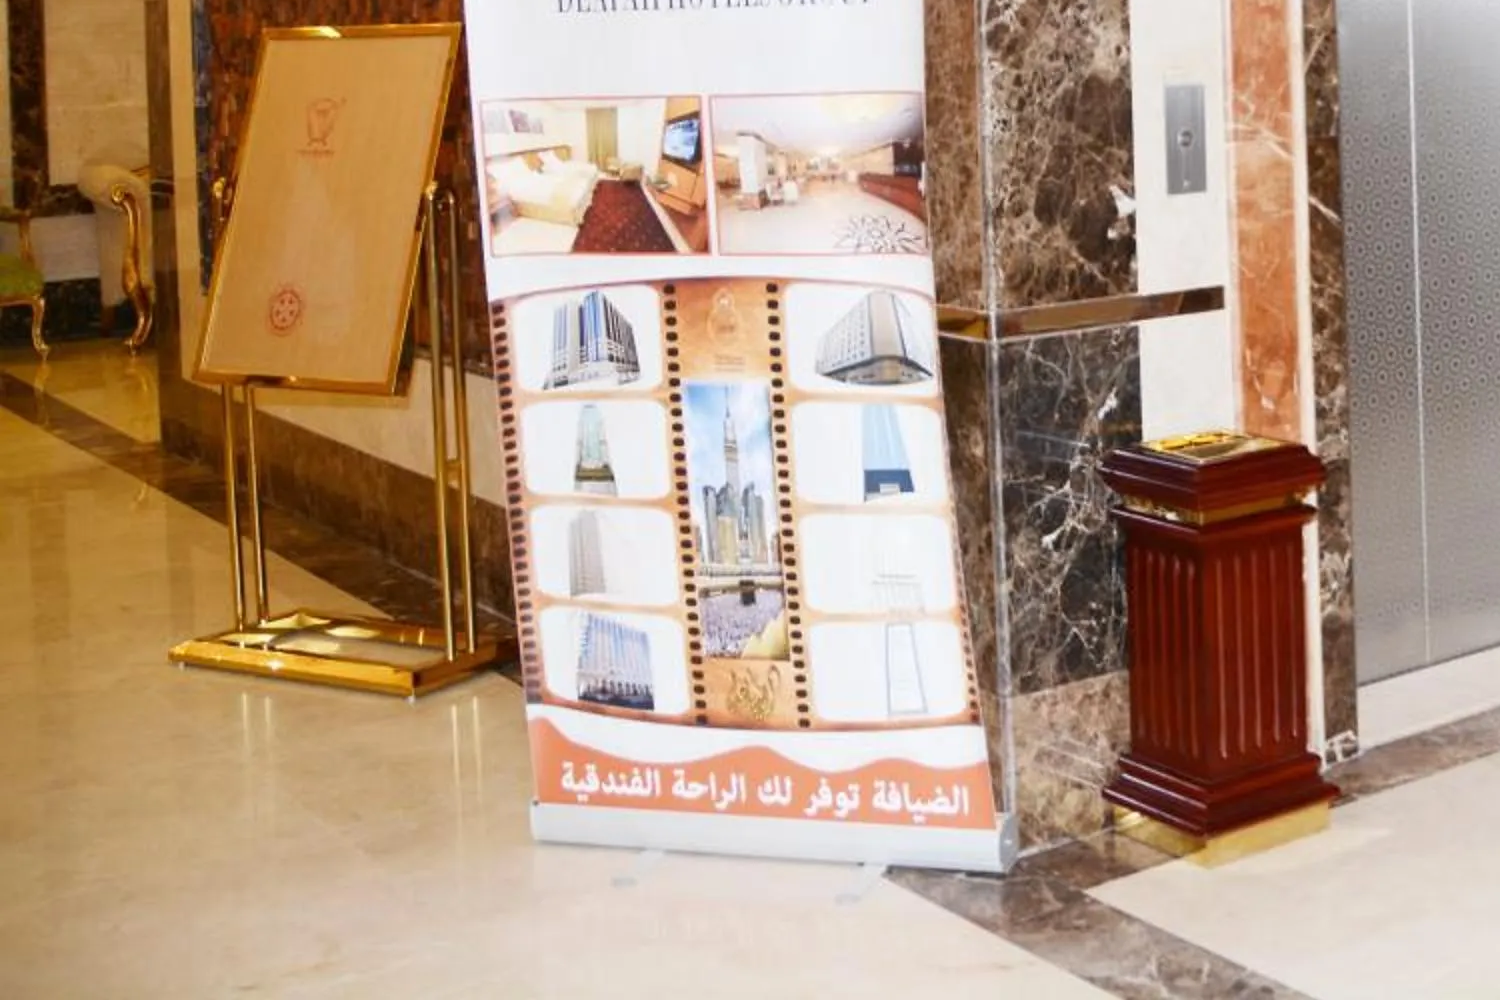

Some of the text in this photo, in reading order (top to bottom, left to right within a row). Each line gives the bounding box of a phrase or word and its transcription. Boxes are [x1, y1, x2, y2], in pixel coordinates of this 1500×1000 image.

[561, 761, 969, 823] الضيافة توفر لك الراحة الفندقية
